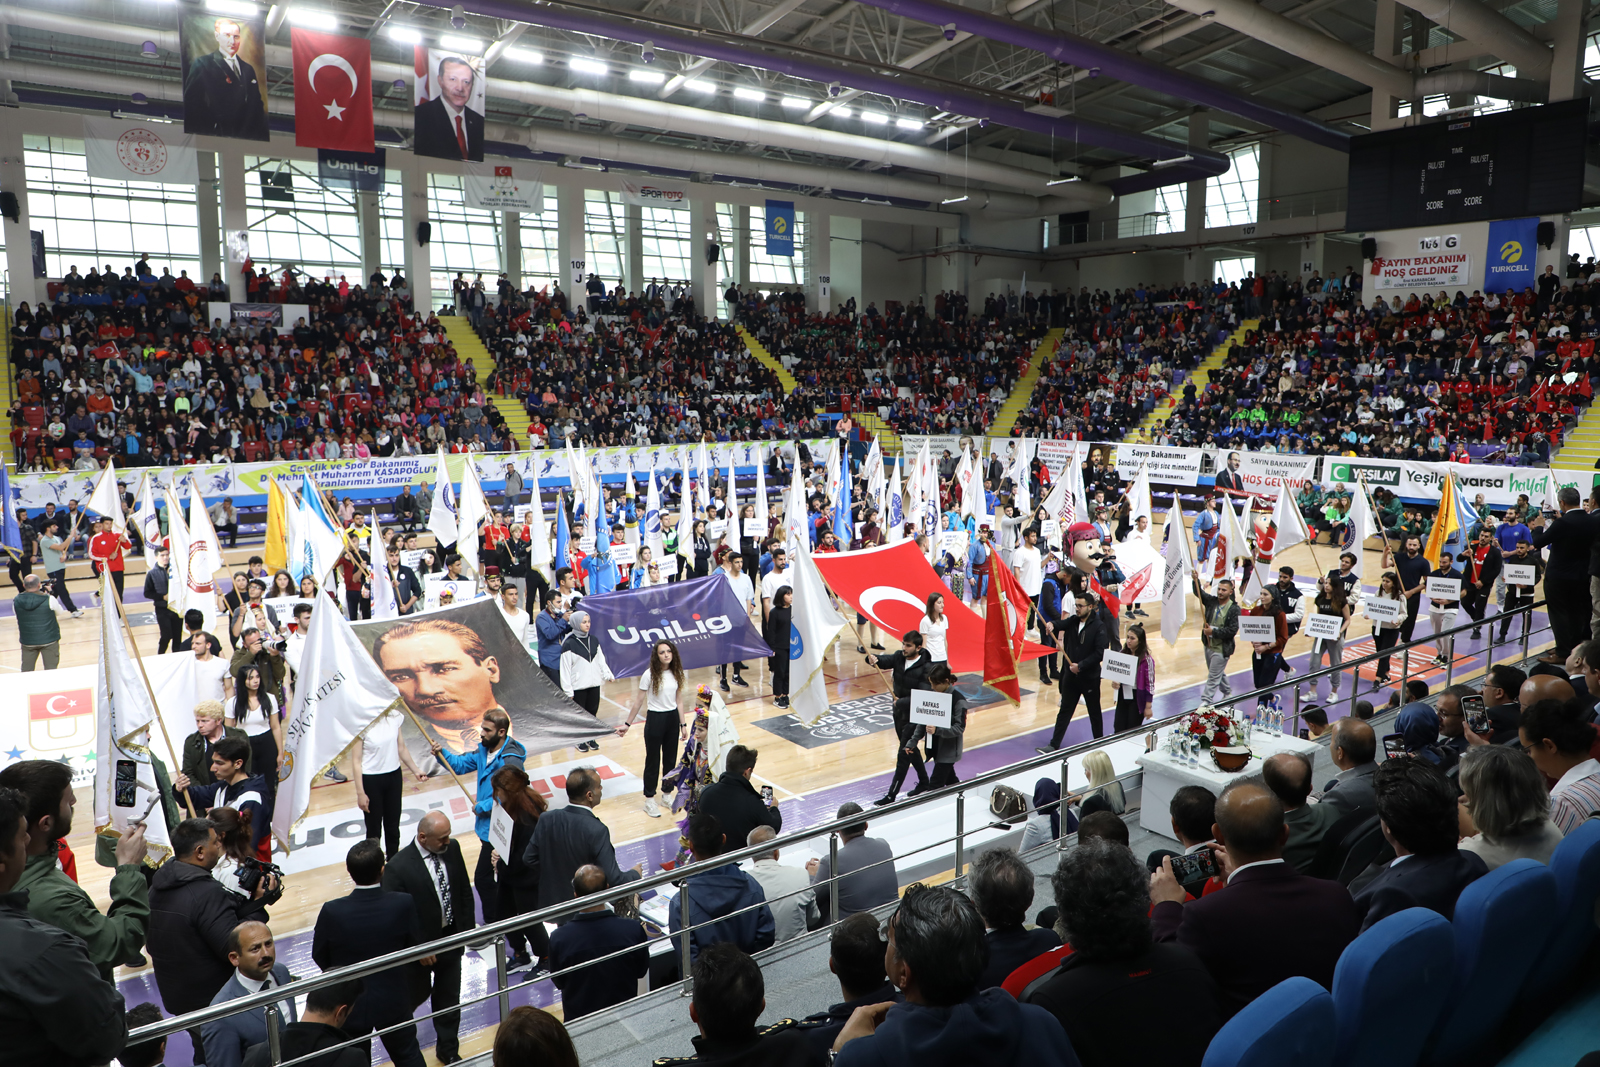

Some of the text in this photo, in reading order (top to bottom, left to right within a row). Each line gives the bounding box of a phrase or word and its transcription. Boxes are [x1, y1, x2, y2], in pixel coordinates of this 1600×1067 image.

[1426, 200, 1444, 210] SCORE
[1464, 196, 1482, 206] SCORE
[1446, 237, 1457, 248] G
[571, 261, 585, 269] 109
[1380, 254, 1466, 268] SAYIN BAKANIM
[1304, 263, 1312, 272] H
[1491, 264, 1529, 273] TURKCELL
[1384, 268, 1406, 278] HOŞ
[576, 274, 582, 283] J
[1152, 451, 1186, 459] Bakanımız
[345, 462, 367, 470] Spor
[370, 460, 419, 468] Bakanımız
[1270, 460, 1307, 468] BAKANIMIZ
[321, 470, 371, 479] Muharrem
[1242, 474, 1262, 486] HOŞ
[1406, 470, 1445, 486] Yeşil
[1460, 478, 1504, 488] varsa
[1509, 473, 1548, 496] hayat
[922, 700, 940, 708] KAFKAS
[916, 706, 946, 716] ÜNİVERSİTESİ
